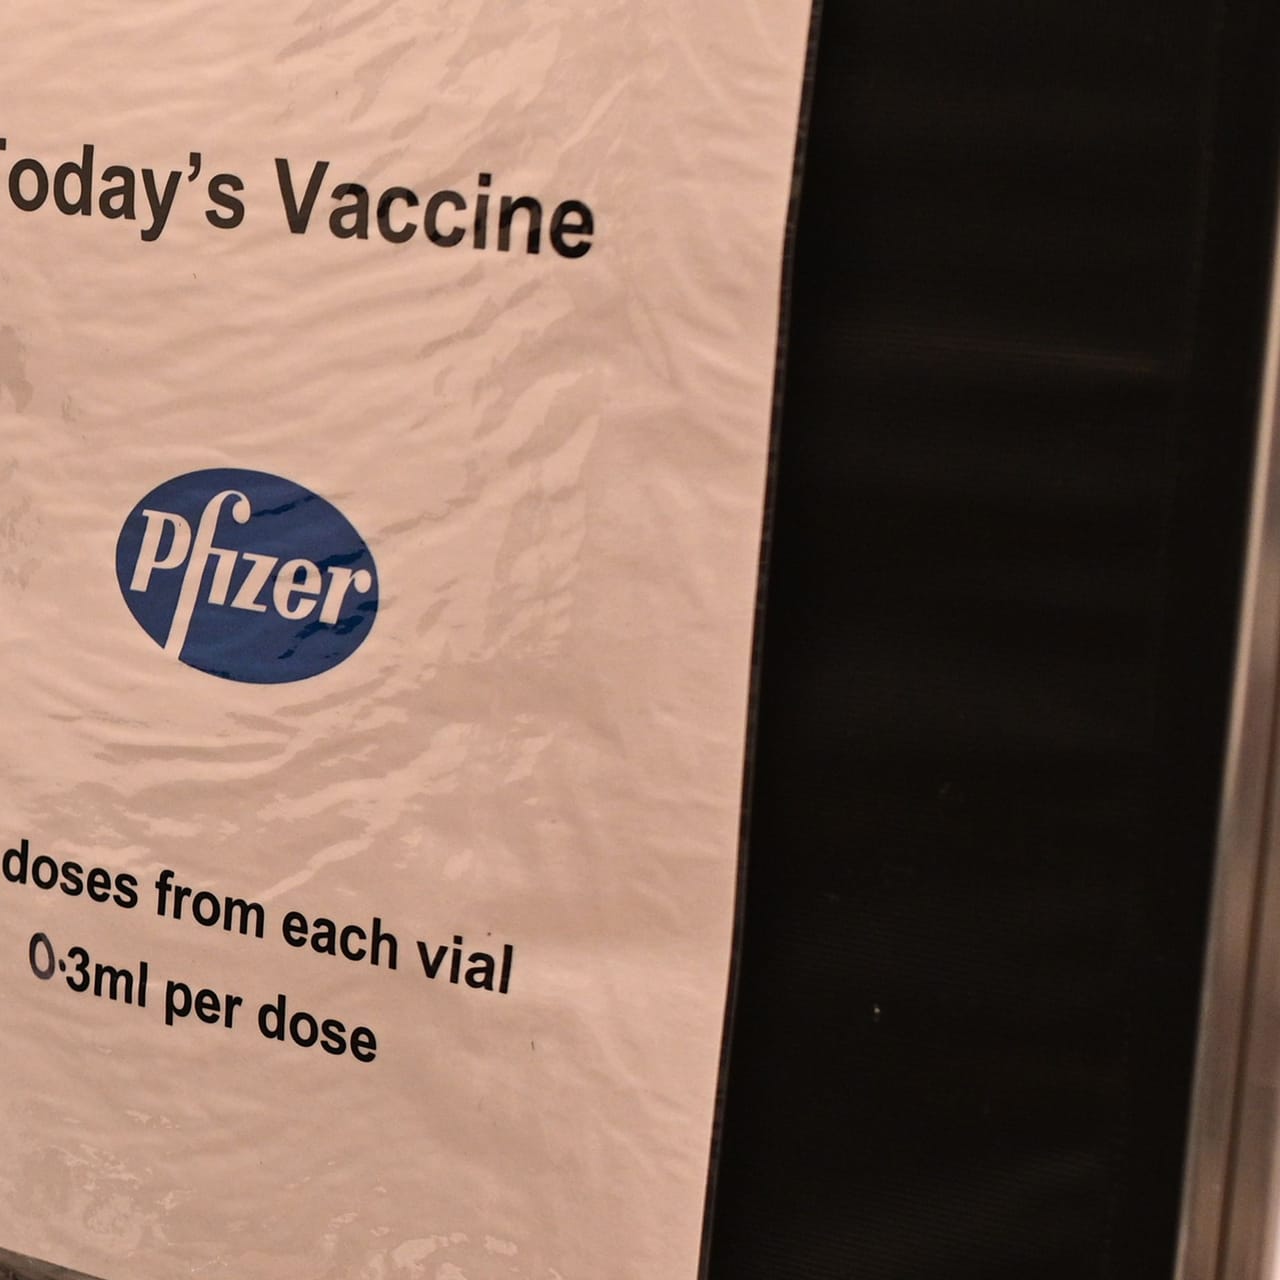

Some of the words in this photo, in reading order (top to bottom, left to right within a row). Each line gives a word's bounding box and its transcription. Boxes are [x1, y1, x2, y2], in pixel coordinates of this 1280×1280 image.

[274, 156, 596, 260] Vaccine
[129, 489, 373, 660] Pfizer
[1, 838, 139, 909] doses
[154, 869, 266, 939] from
[281, 909, 399, 971] each
[415, 934, 515, 995] vial
[164, 978, 244, 1027] per
[257, 993, 378, 1064] dose
